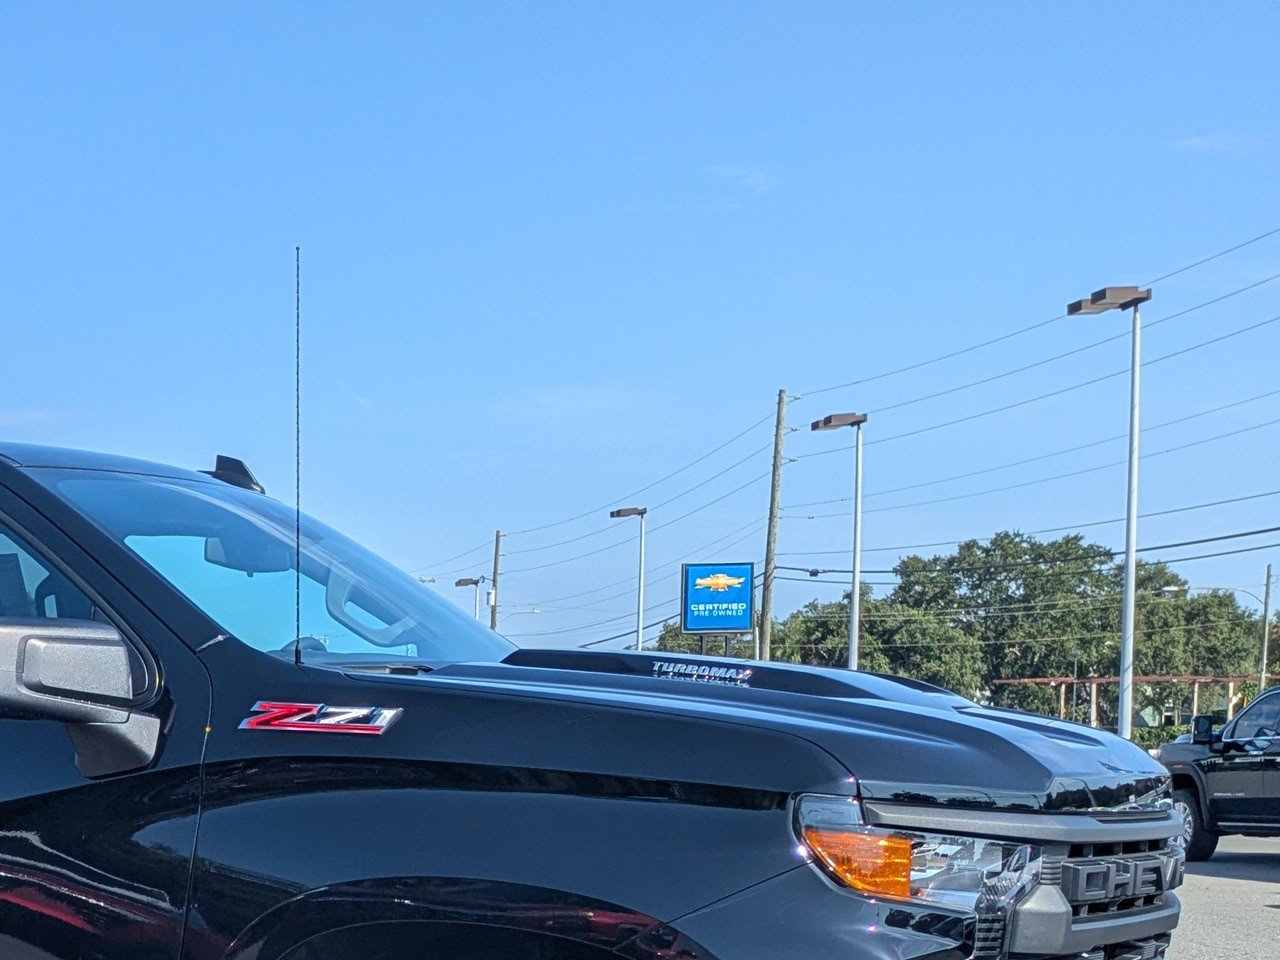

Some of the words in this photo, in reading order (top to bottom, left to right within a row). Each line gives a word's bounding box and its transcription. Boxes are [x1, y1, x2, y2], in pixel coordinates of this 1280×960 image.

[691, 603, 746, 611] CERTIFIED
[694, 609, 743, 617] PRE-OWNED
[652, 661, 753, 680] TURBOMAX
[237, 700, 404, 735] Z71
